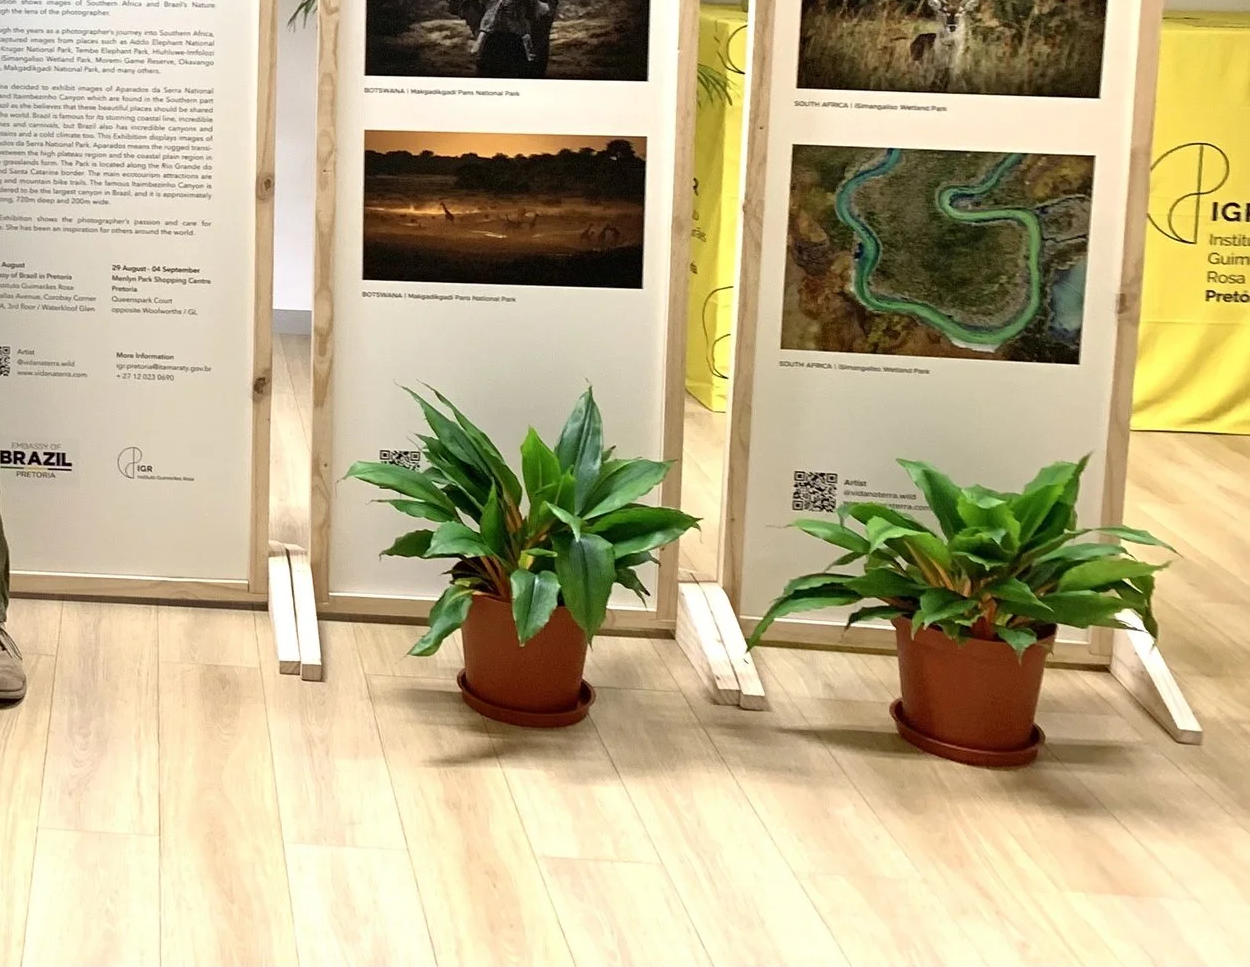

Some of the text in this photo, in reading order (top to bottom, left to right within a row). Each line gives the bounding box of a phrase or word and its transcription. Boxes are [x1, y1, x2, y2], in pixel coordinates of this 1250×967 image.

[1212, 202, 1250, 222] IG
[1210, 234, 1250, 246] Instit
[18, 271, 38, 279] Brazil
[45, 272, 73, 280] Pretoria
[111, 274, 212, 285] Menlyn Park Shopping Centre
[1206, 270, 1246, 284] Rosa
[111, 284, 138, 292] Pretoria
[134, 352, 175, 360] Information
[16, 370, 88, 378] www.vidanaterra.com
[11, 442, 47, 450] EMBASSY
[0, 450, 72, 467] BRAZIL
[137, 464, 153, 473] IGR
[16, 470, 56, 479] PRETORIA
[843, 478, 867, 487] Artist
